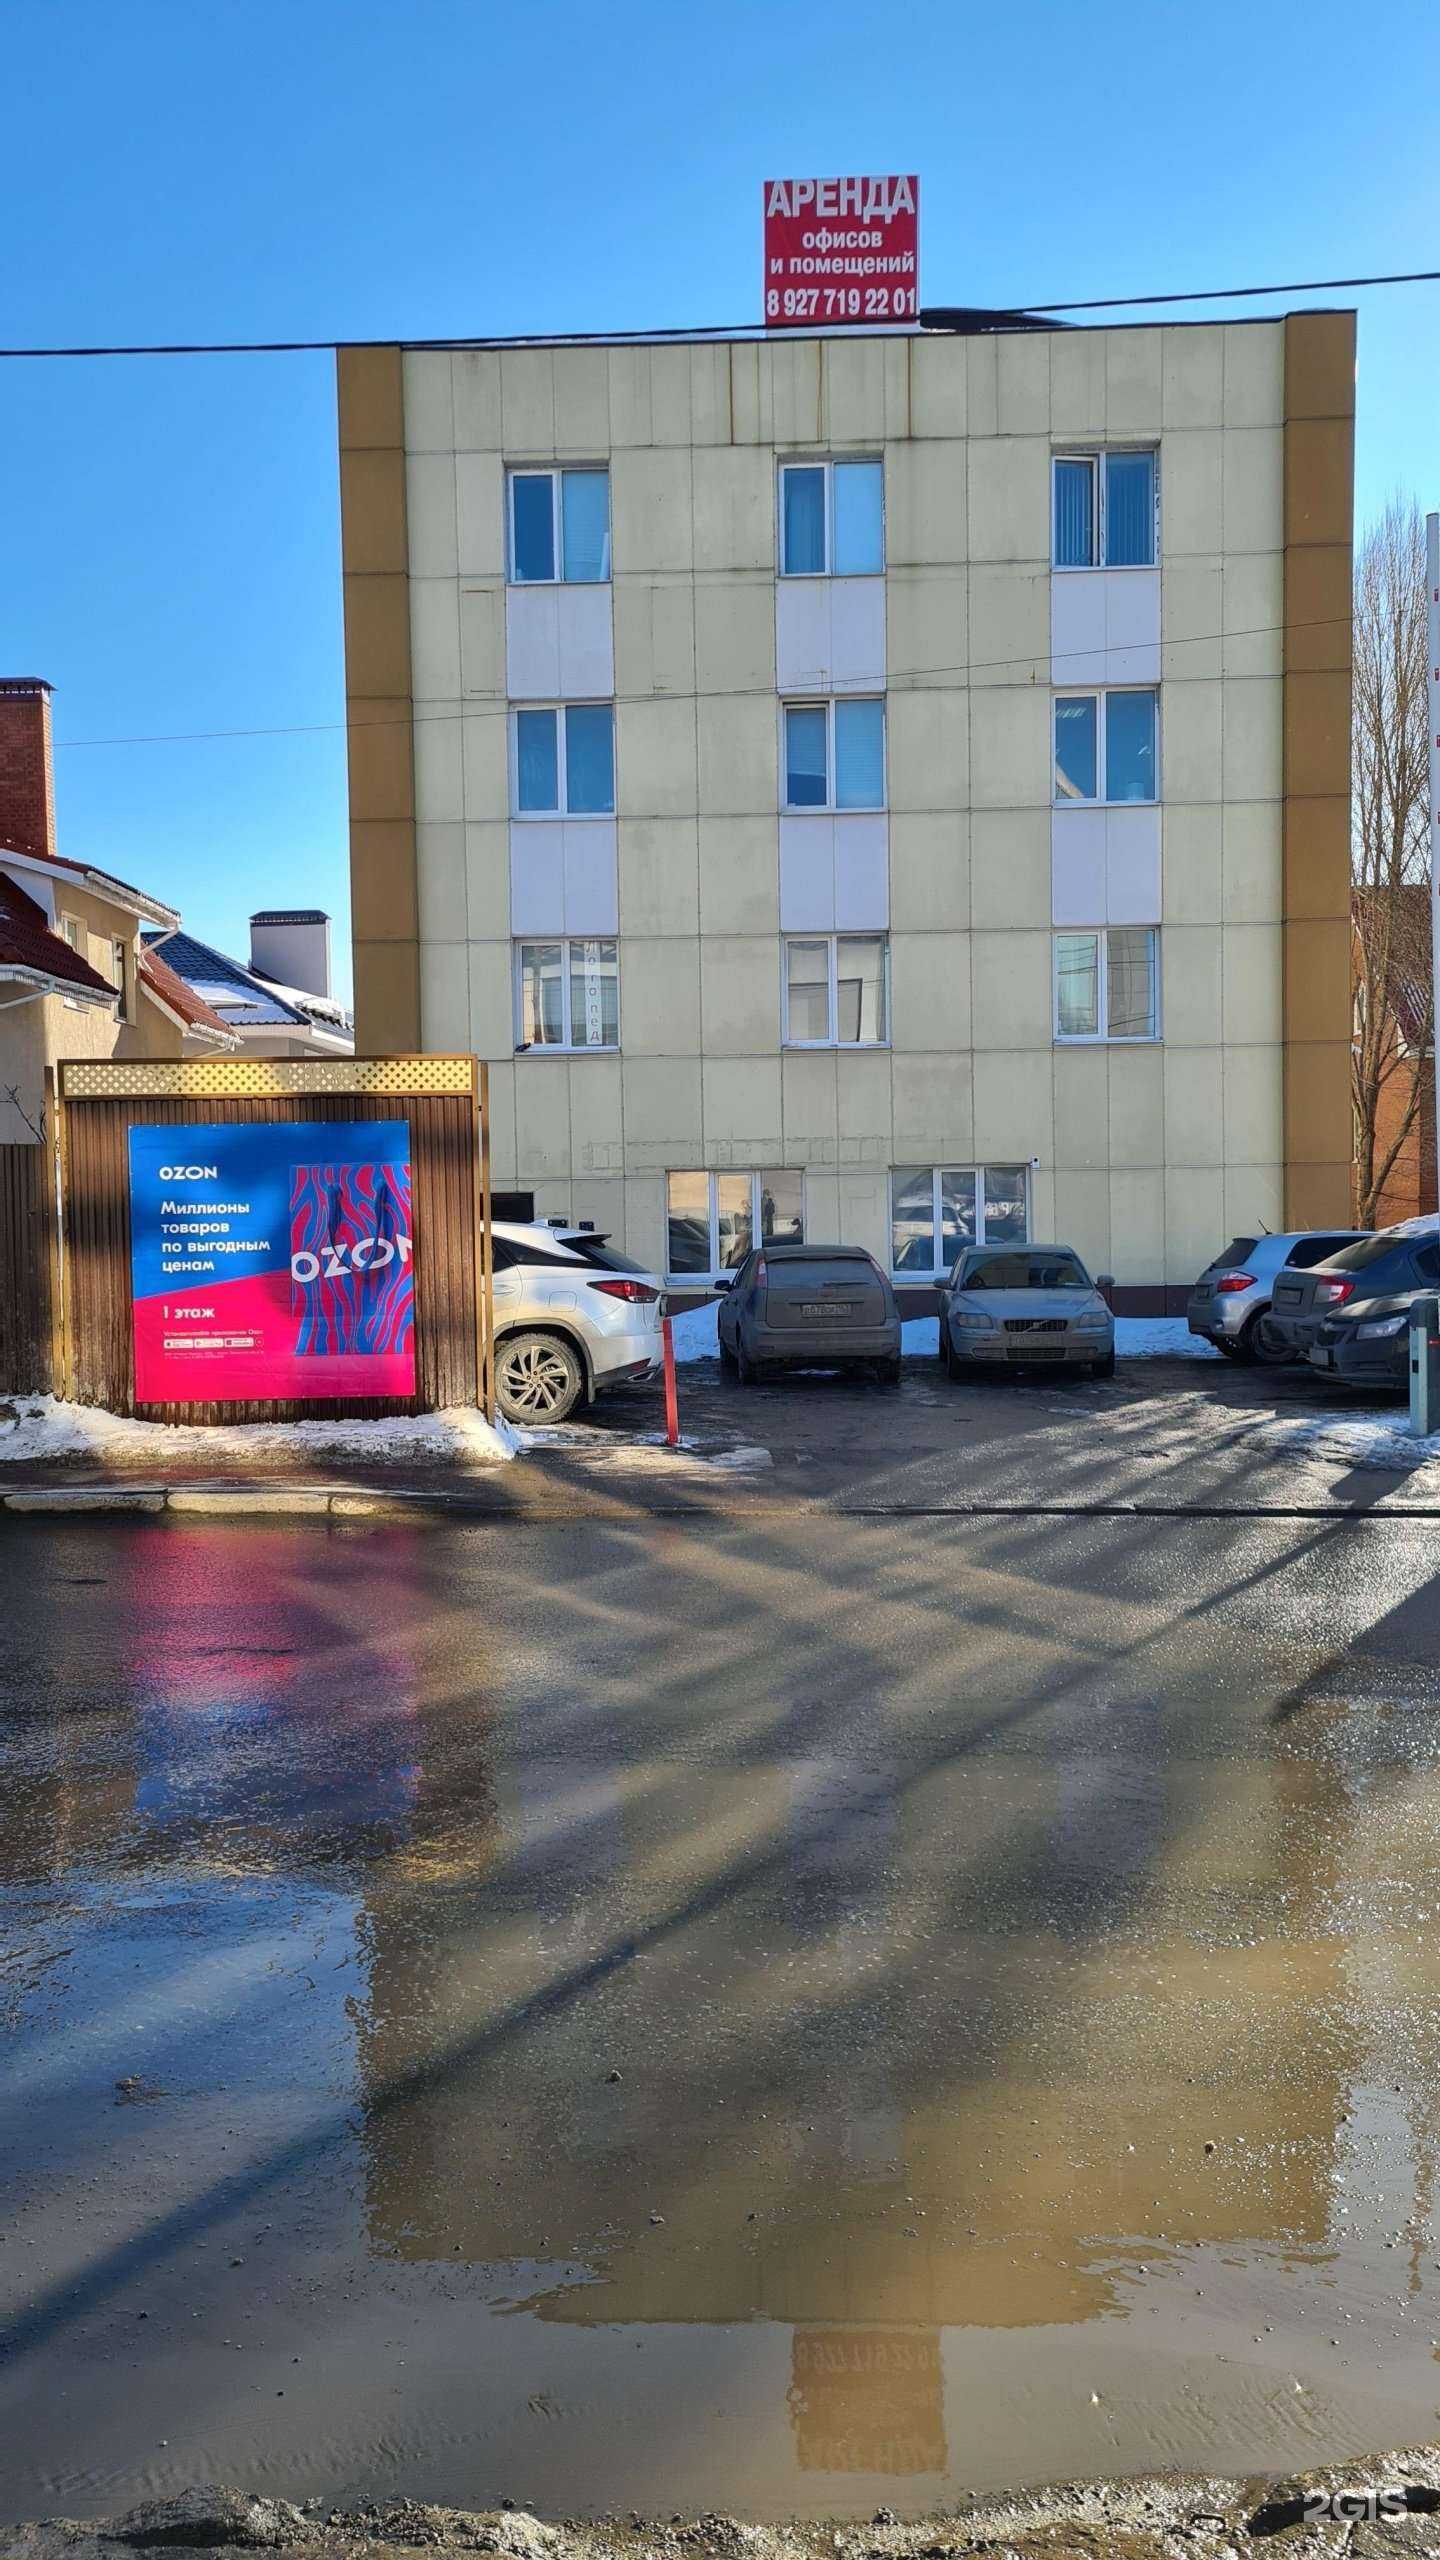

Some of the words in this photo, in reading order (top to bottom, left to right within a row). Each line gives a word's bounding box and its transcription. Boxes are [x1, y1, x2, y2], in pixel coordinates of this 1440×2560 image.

[767, 176, 915, 224] АРЕНДА
[802, 227, 882, 253] офисов
[771, 258, 783, 274] и
[789, 251, 914, 277] помещений
[767, 289, 779, 316] 8
[784, 289, 819, 316] 927
[823, 288, 860, 315] 719
[865, 288, 888, 315] 22
[893, 287, 915, 315] 01
[159, 1166, 218, 1180] OZON
[160, 1201, 250, 1215] Миллионы
[161, 1222, 230, 1236] товаров
[162, 1242, 182, 1252] по
[188, 1241, 271, 1253] выгодным
[162, 1260, 214, 1273] ценам
[174, 1308, 215, 1319] этаж
